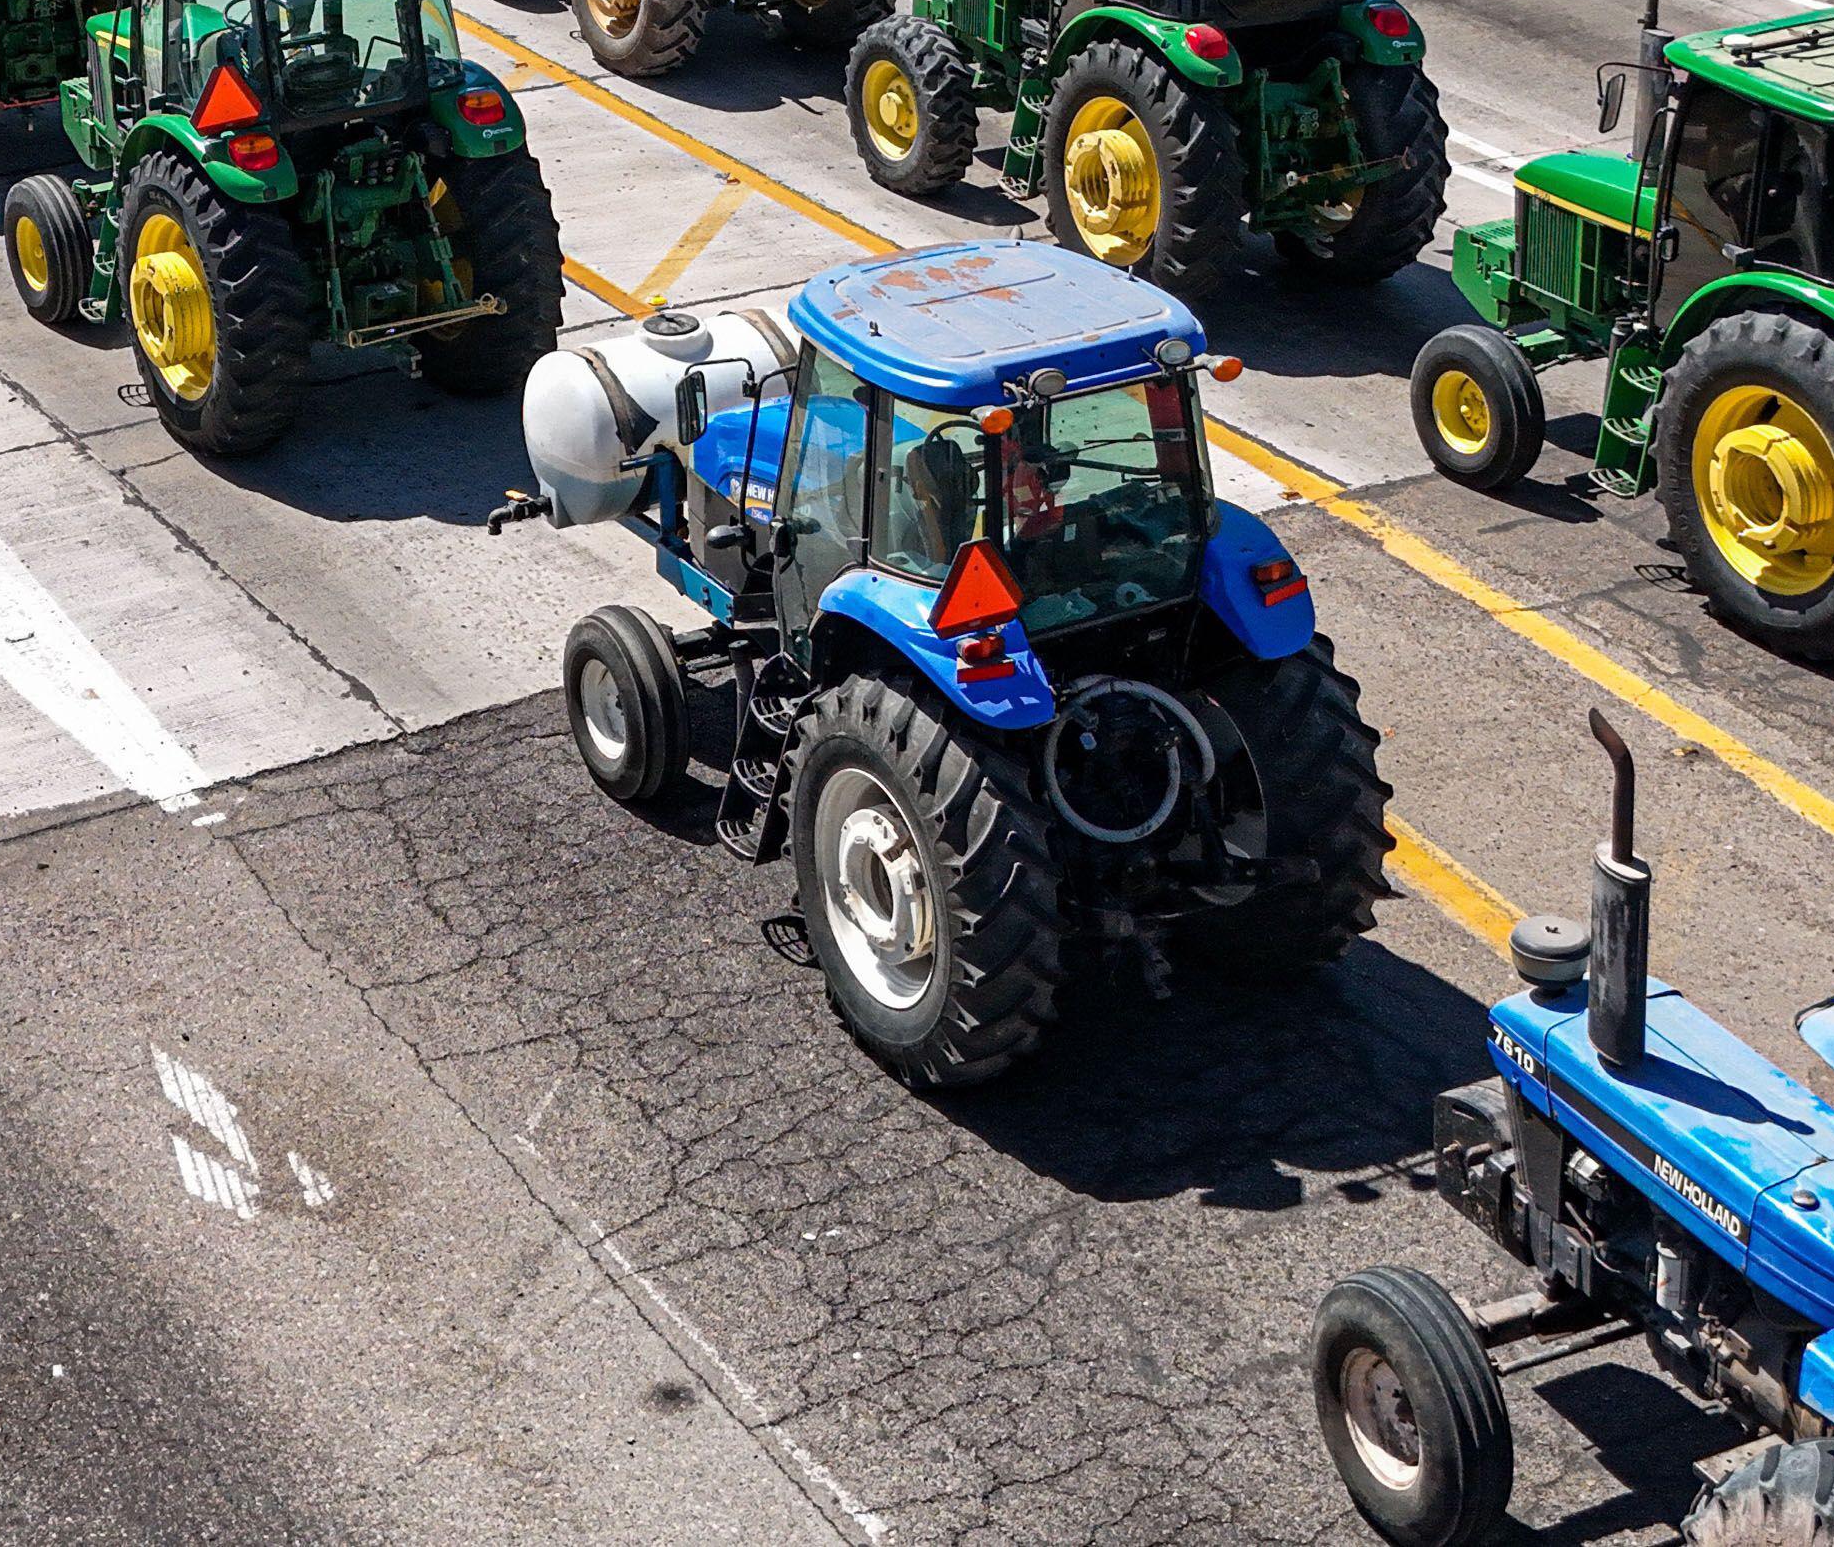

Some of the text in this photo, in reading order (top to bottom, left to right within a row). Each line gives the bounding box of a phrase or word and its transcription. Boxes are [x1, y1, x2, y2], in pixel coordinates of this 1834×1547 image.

[747, 483, 766, 501] NEW
[1493, 1025, 1534, 1074] 7610
[1653, 1154, 1741, 1237] NEW HOLLAND
